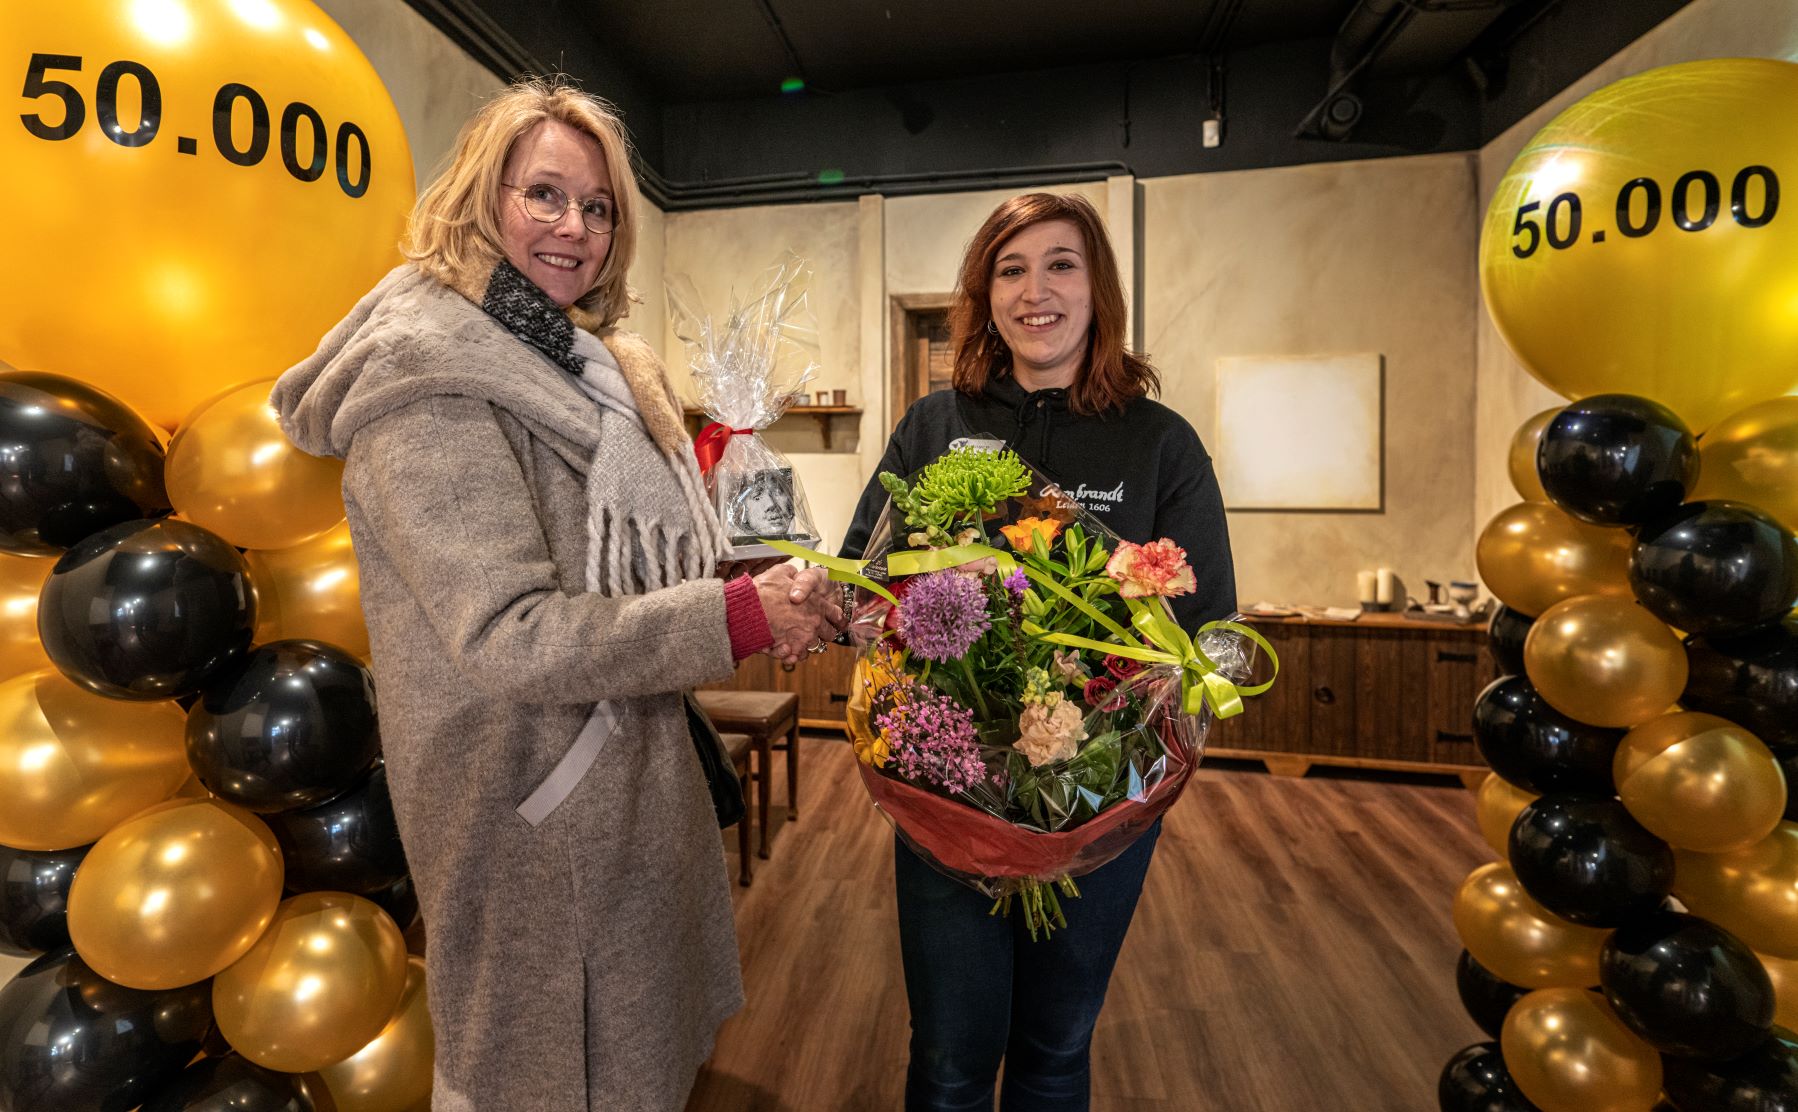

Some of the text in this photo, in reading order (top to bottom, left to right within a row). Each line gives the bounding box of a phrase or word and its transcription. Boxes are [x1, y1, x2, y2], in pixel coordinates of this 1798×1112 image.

[20, 53, 372, 199] 50.000
[1512, 164, 1781, 259] 50.000
[1039, 480, 1124, 502] Rmbrandt
[1088, 503, 1111, 512] 1606
